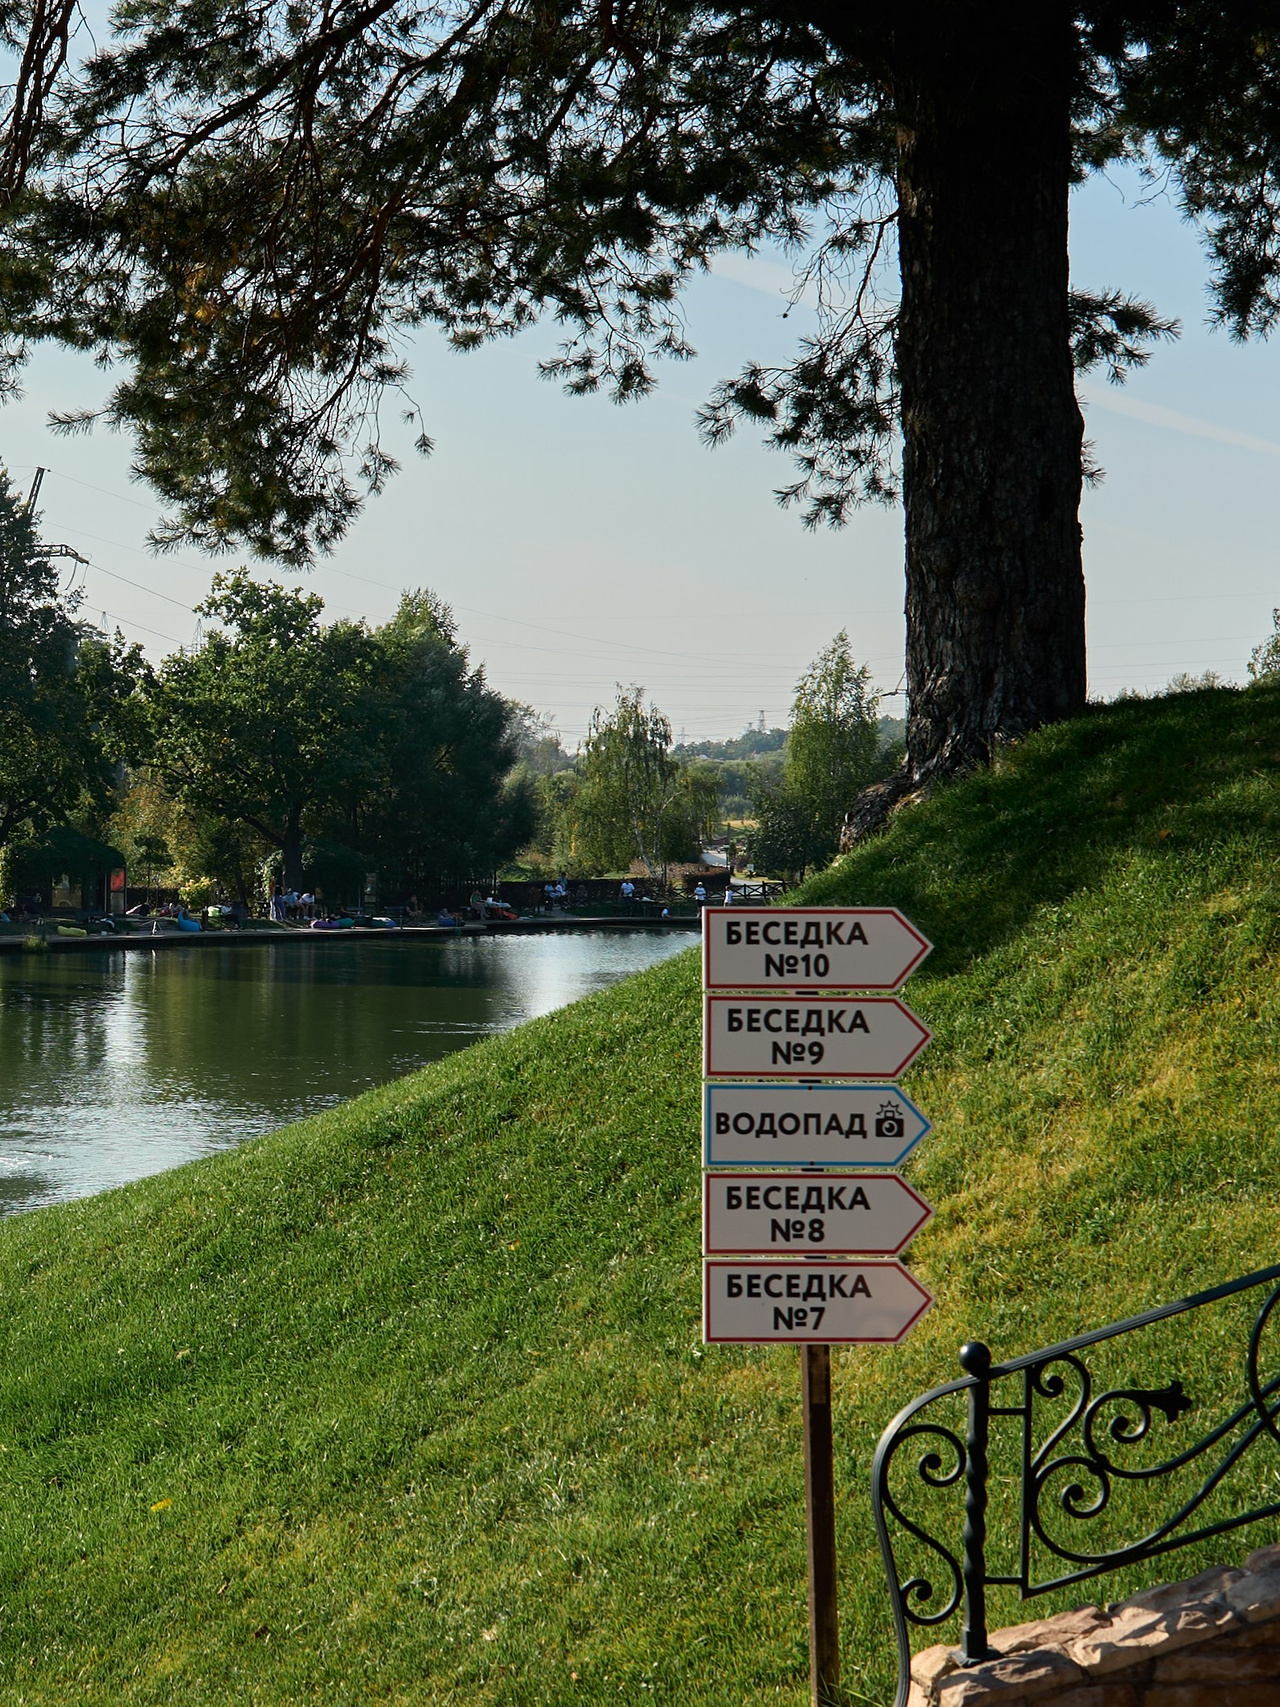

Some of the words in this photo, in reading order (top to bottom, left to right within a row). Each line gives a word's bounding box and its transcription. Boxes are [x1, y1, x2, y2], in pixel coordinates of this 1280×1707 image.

[725, 920, 870, 949] БЕСЕДКА
[764, 953, 830, 978] №10
[727, 1007, 871, 1037] БЕСЕДКА
[771, 1040, 825, 1066] №9
[715, 1111, 868, 1139] ВОДОПАД
[725, 1185, 872, 1214] БЕСЕДКА
[770, 1217, 826, 1243] №8
[726, 1273, 873, 1302] БЕСЕДКА
[772, 1306, 826, 1331] №7
